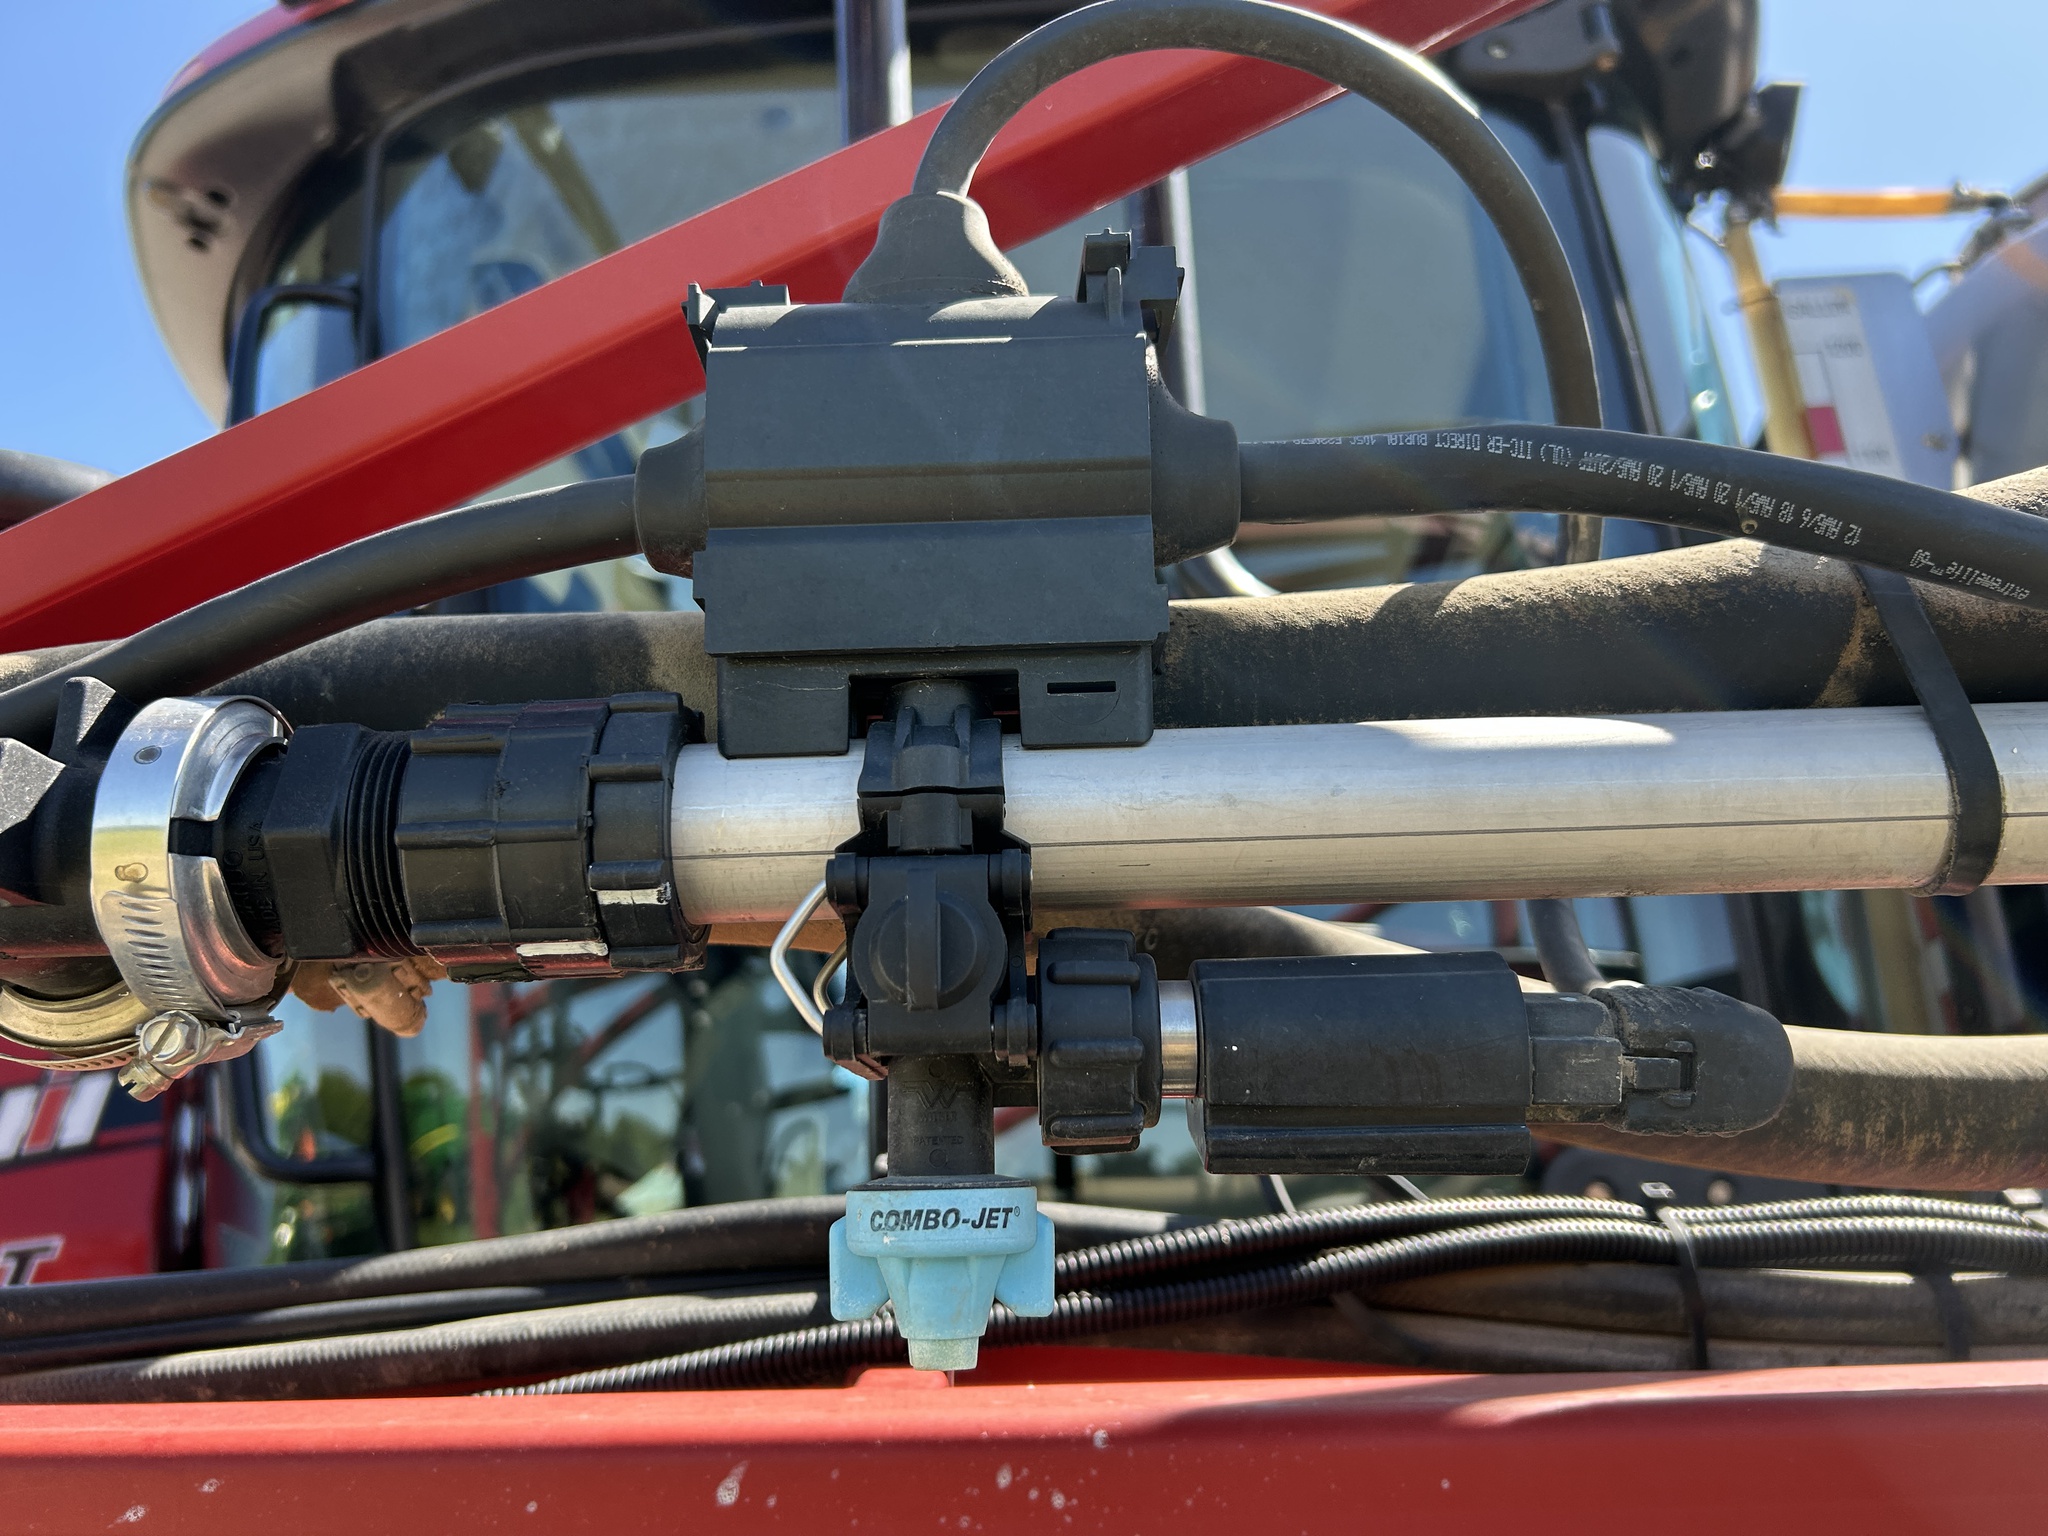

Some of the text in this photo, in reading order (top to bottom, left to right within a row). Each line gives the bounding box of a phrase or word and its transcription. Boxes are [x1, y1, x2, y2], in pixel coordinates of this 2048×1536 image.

[1383, 433, 1428, 447] BURIAL
[1434, 432, 1481, 451] DIRECT
[1487, 434, 1533, 460] ITC-ER
[1539, 443, 1573, 468] (UL)
[1646, 464, 1665, 488] 20
[1669, 469, 1711, 500] AWG/1
[1713, 481, 1732, 505] 20
[1734, 488, 1777, 519] AWG/1
[1777, 501, 1796, 524] 18
[1798, 507, 1843, 541] AWG/6
[1843, 523, 1862, 547] 12
[247, 820, 265, 861] USA
[913, 1134, 965, 1147] PATENTED
